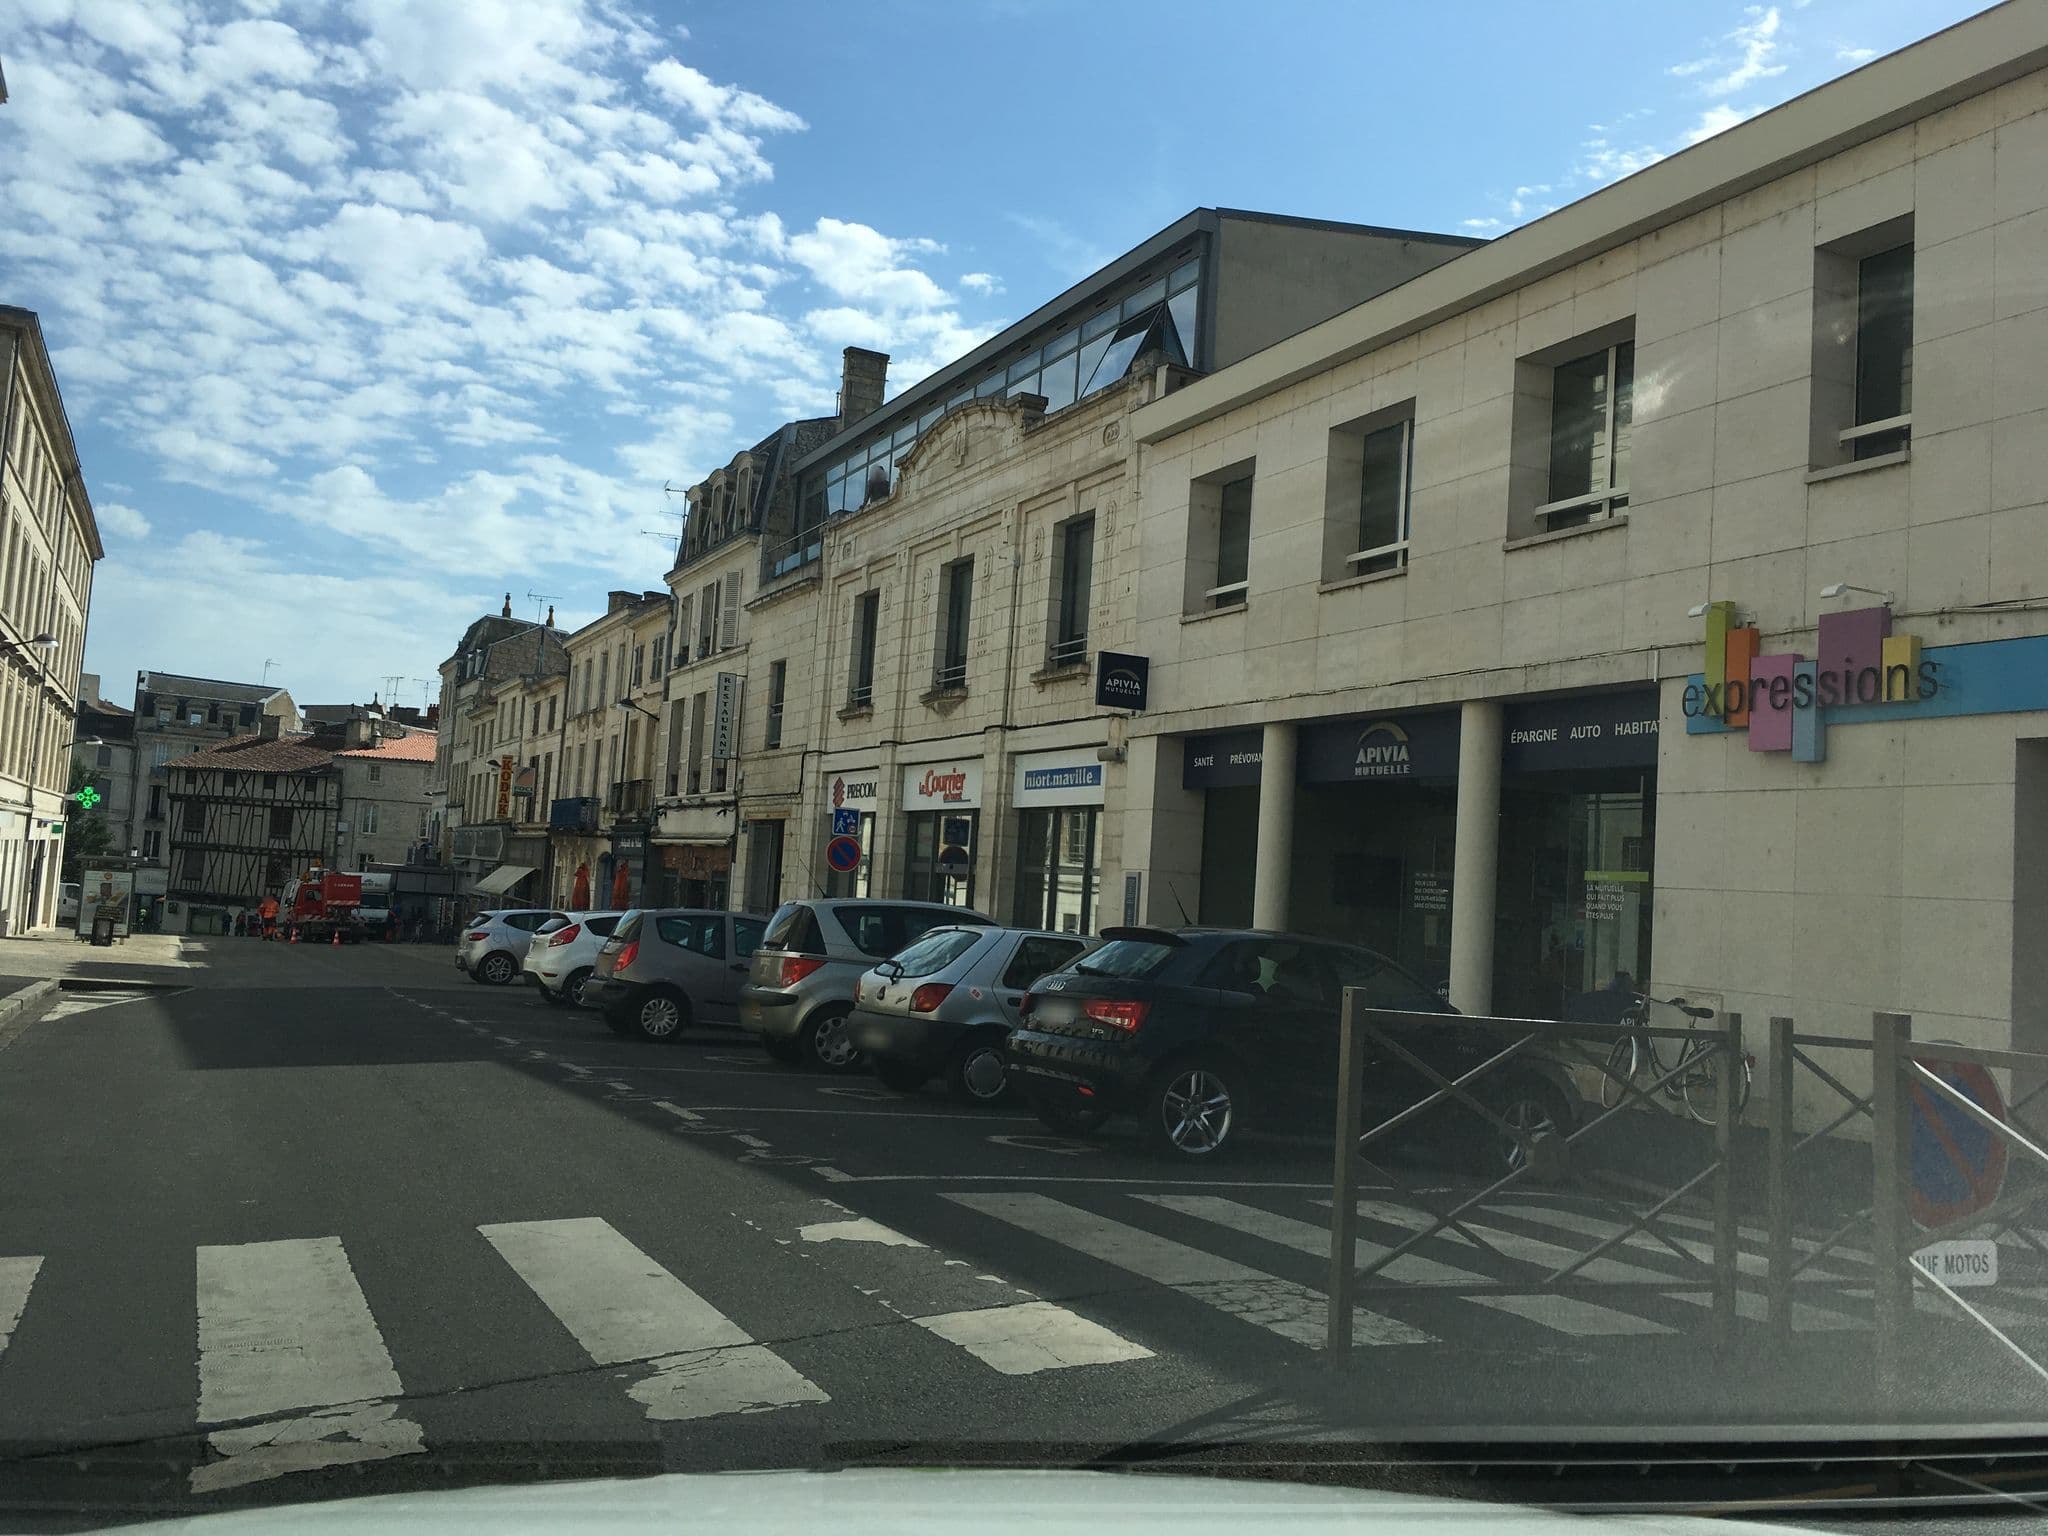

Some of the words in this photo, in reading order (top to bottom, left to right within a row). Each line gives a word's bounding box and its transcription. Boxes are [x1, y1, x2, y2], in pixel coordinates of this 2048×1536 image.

[1105, 678, 1140, 690] APIVIA
[1682, 657, 1939, 724] expressions
[719, 677, 731, 755] RESTAURANT
[1511, 729, 1557, 744] ÉPARGNE
[1570, 725, 1601, 739] AUTO
[1194, 754, 1214, 767] SANTÉ
[1356, 745, 1409, 763] APIVIA
[1355, 764, 1411, 776] MUTUELLE
[497, 759, 512, 815] KODAK
[925, 767, 966, 797] Courrier
[1944, 1254, 1989, 1274] MOTOS
